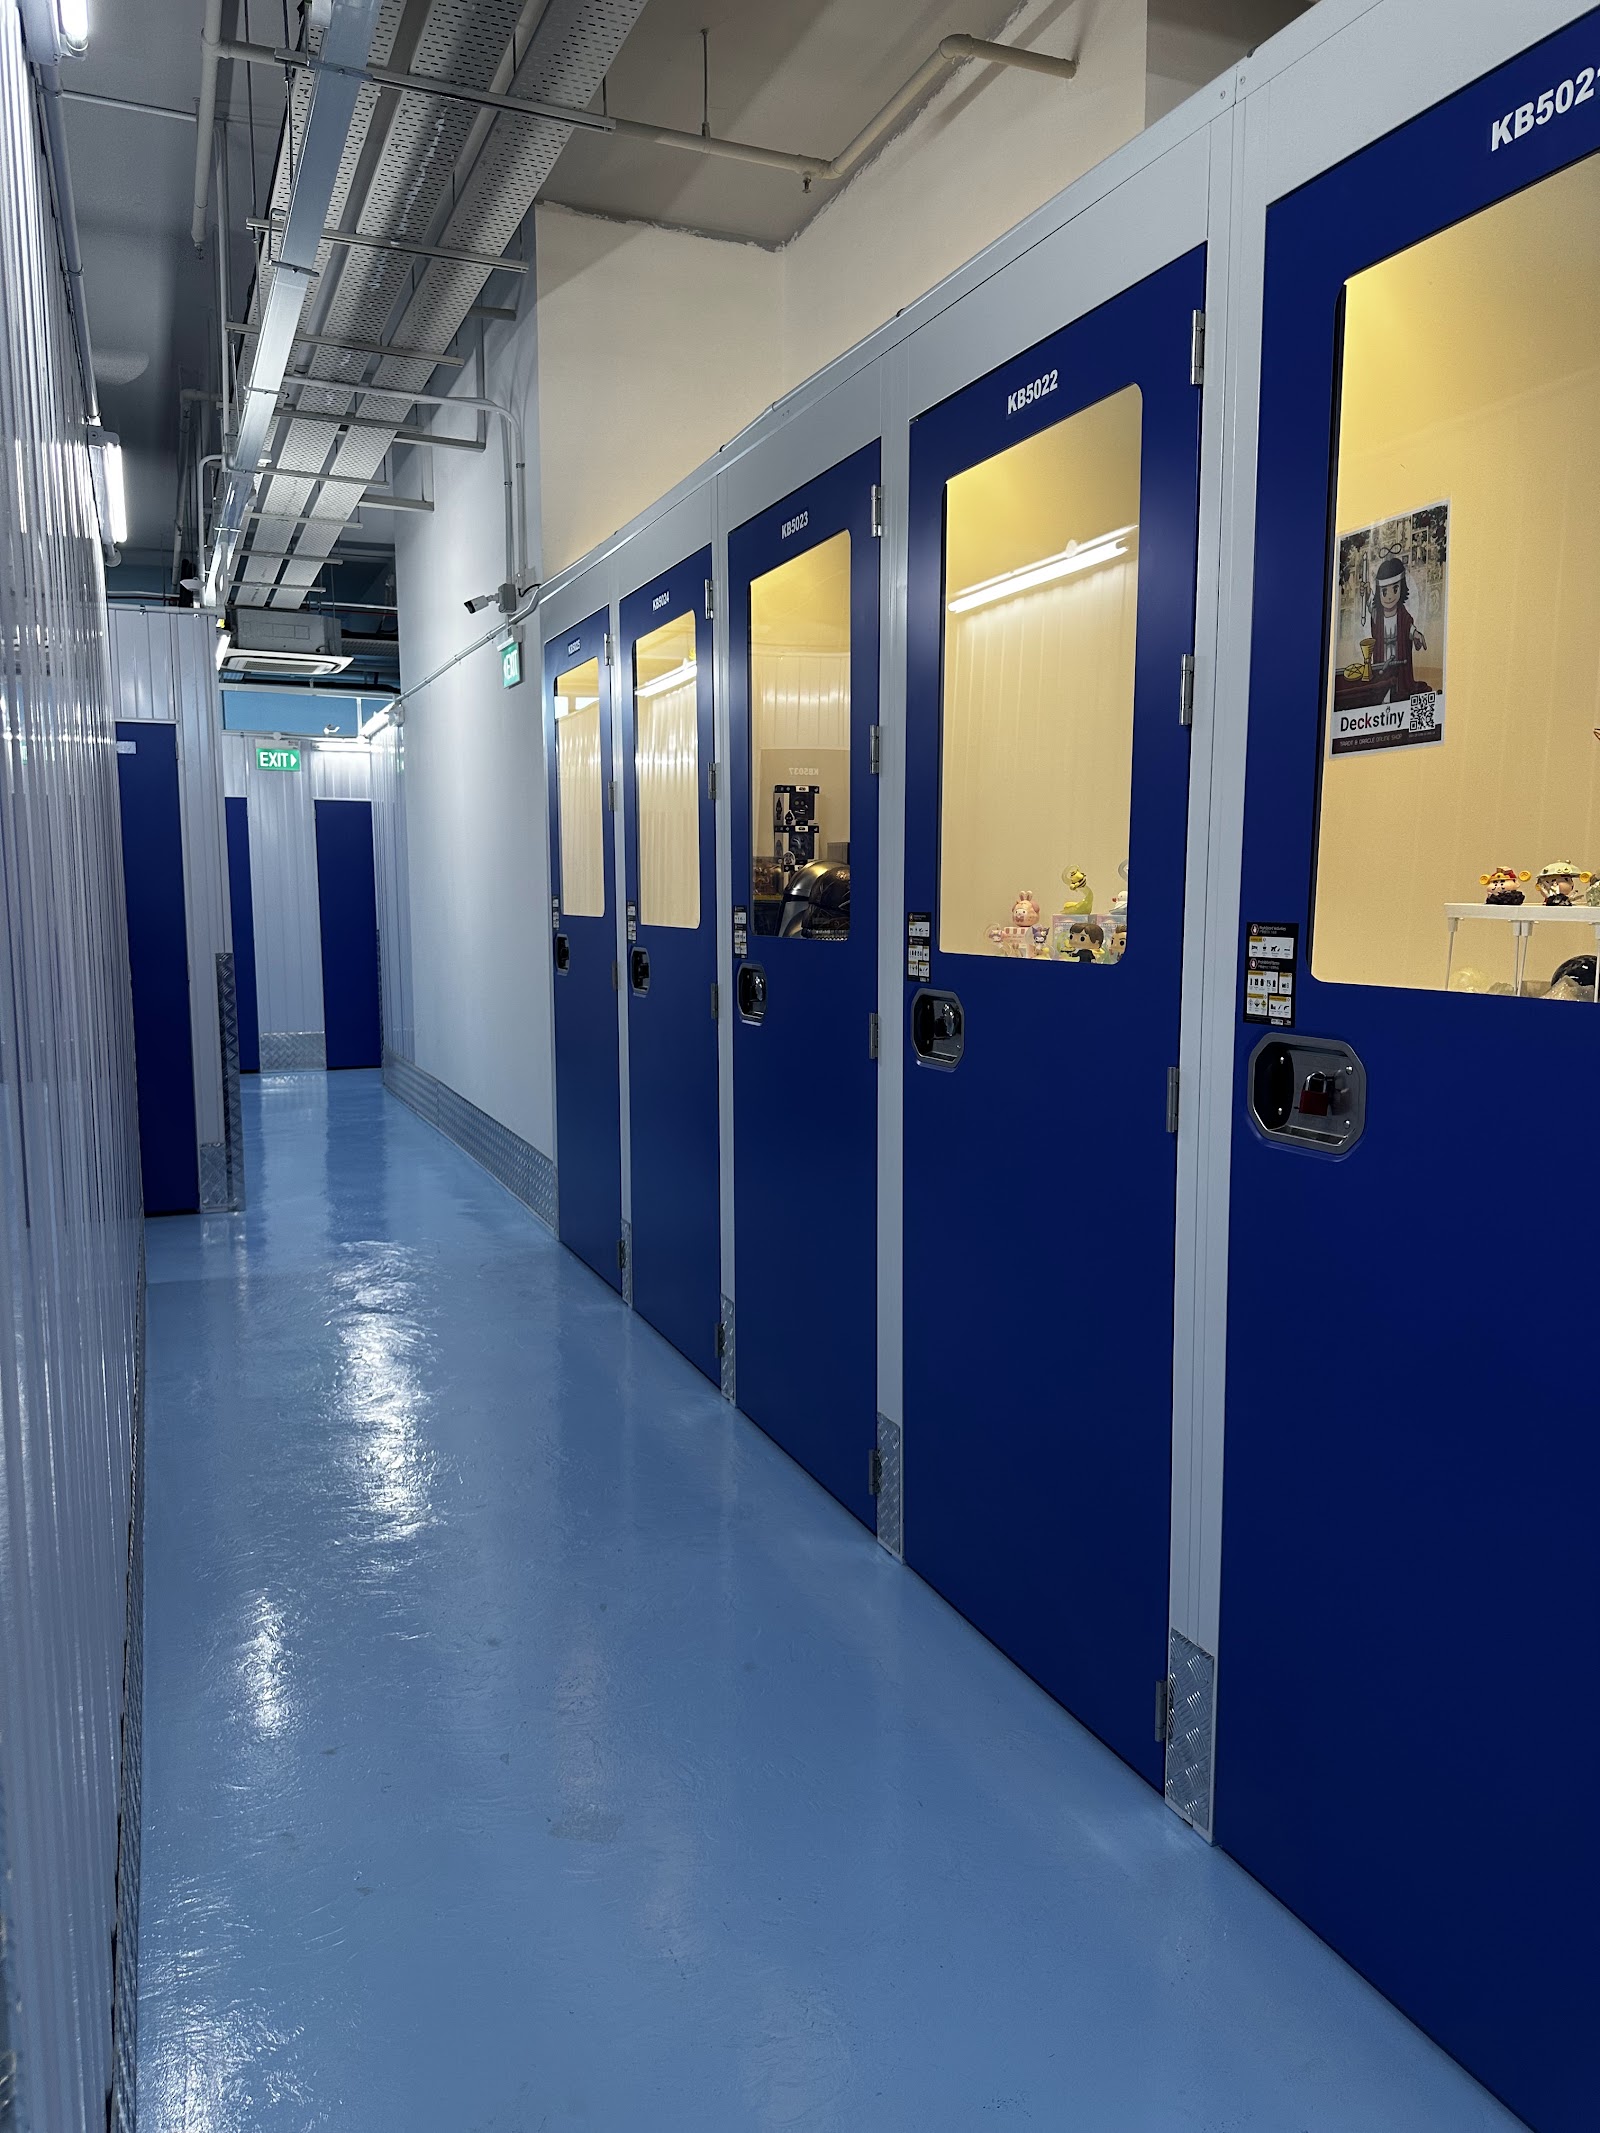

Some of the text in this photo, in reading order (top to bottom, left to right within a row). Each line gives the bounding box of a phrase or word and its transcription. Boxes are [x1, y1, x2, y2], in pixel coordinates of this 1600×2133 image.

[1491, 66, 1600, 152] KB502
[1007, 369, 1058, 415] KB5022
[781, 510, 808, 540] KB5023
[1340, 706, 1405, 732] Deckstiny
[260, 751, 288, 767] EXIT
